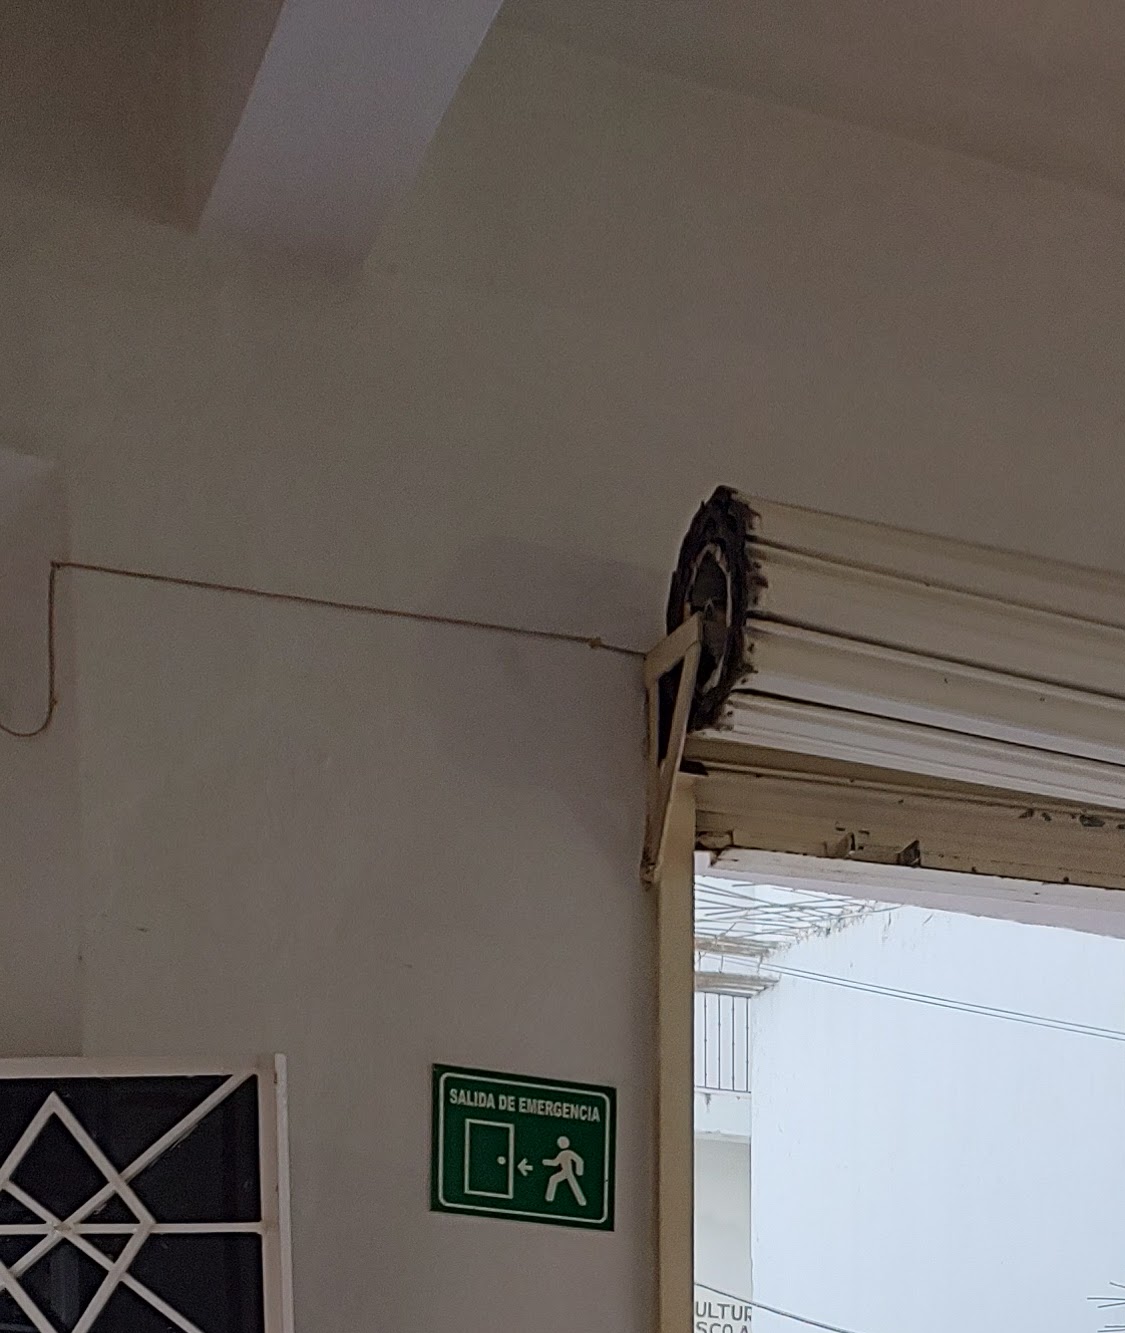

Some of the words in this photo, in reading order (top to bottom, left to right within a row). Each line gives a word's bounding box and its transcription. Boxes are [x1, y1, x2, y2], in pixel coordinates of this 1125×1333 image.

[449, 1088, 496, 1110] SALIDA
[498, 1094, 516, 1112] DE
[518, 1097, 601, 1122] EMERGENCIA
